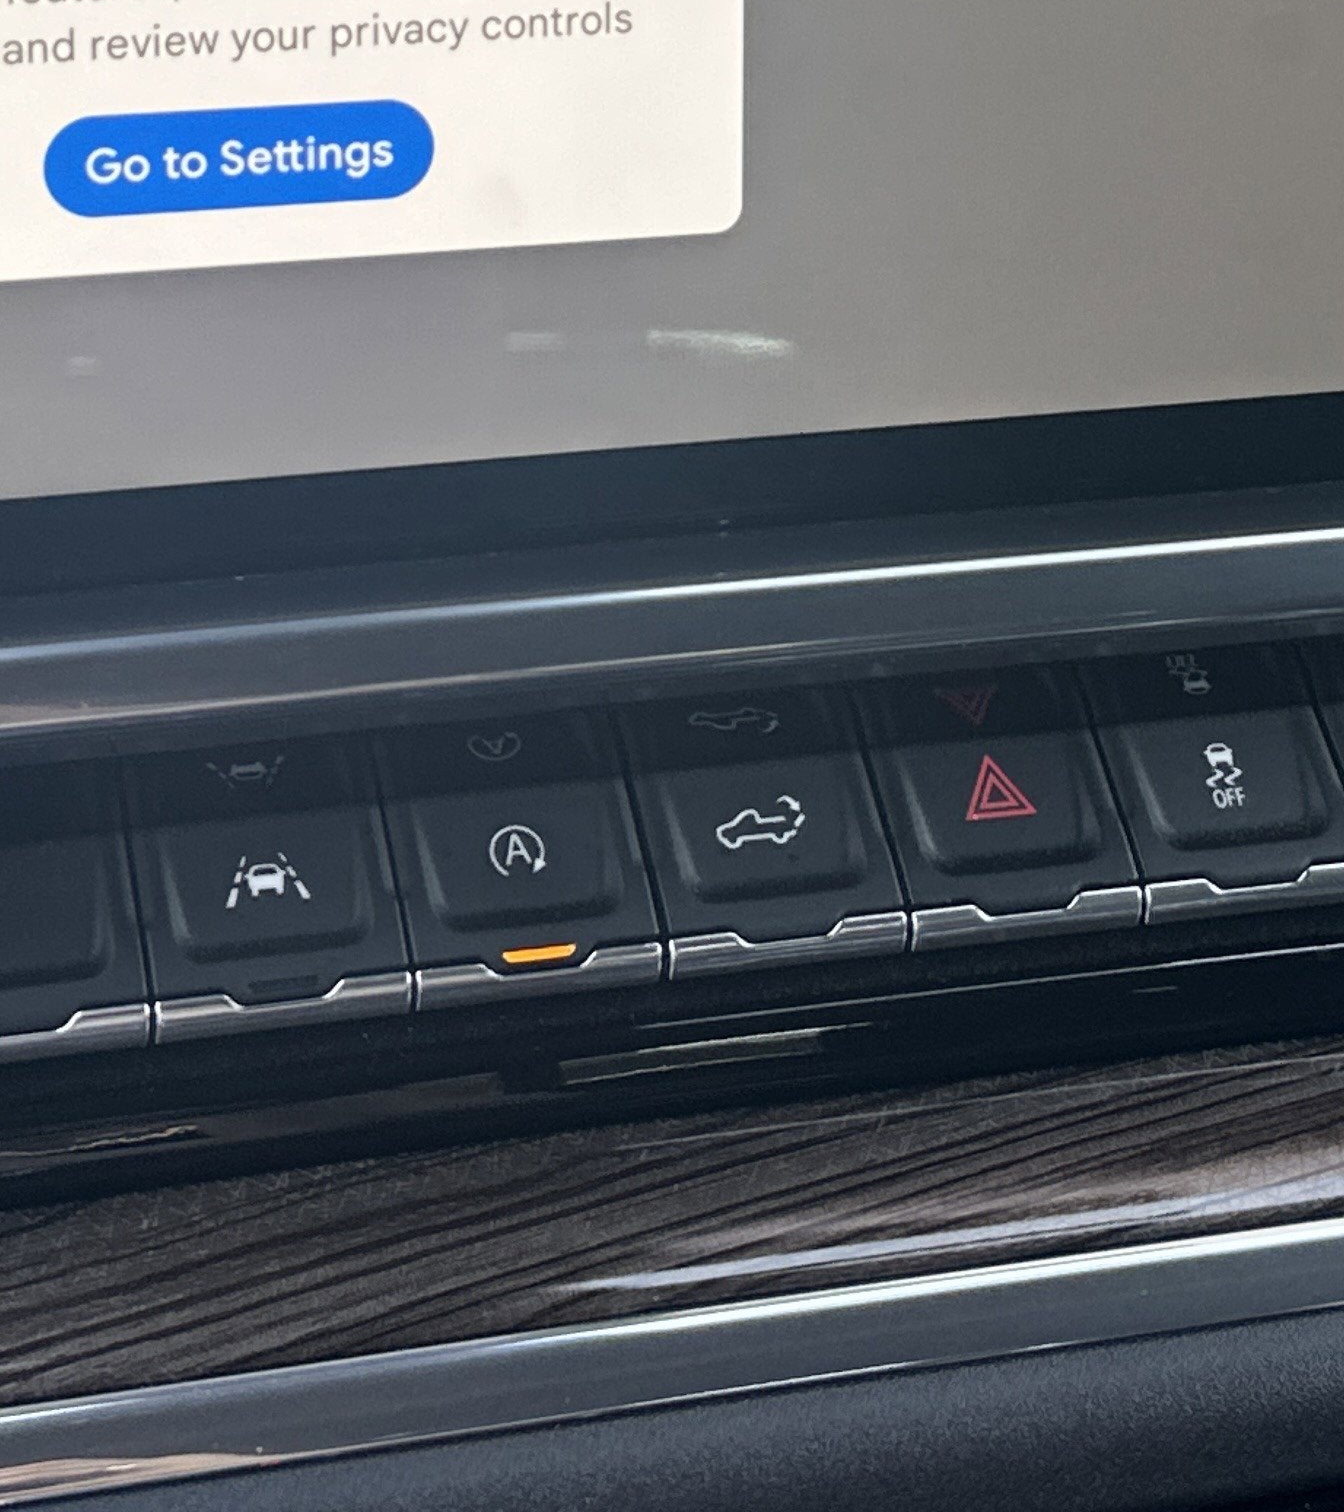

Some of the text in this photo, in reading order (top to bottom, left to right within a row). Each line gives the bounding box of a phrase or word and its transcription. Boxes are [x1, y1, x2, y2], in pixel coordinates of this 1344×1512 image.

[2, 26, 75, 66] and
[90, 22, 220, 61] review
[230, 24, 316, 63] your
[330, 12, 470, 58] privacy
[481, 0, 633, 41] controls
[84, 135, 394, 185] Go to Settings
[1212, 787, 1246, 809] OFF
